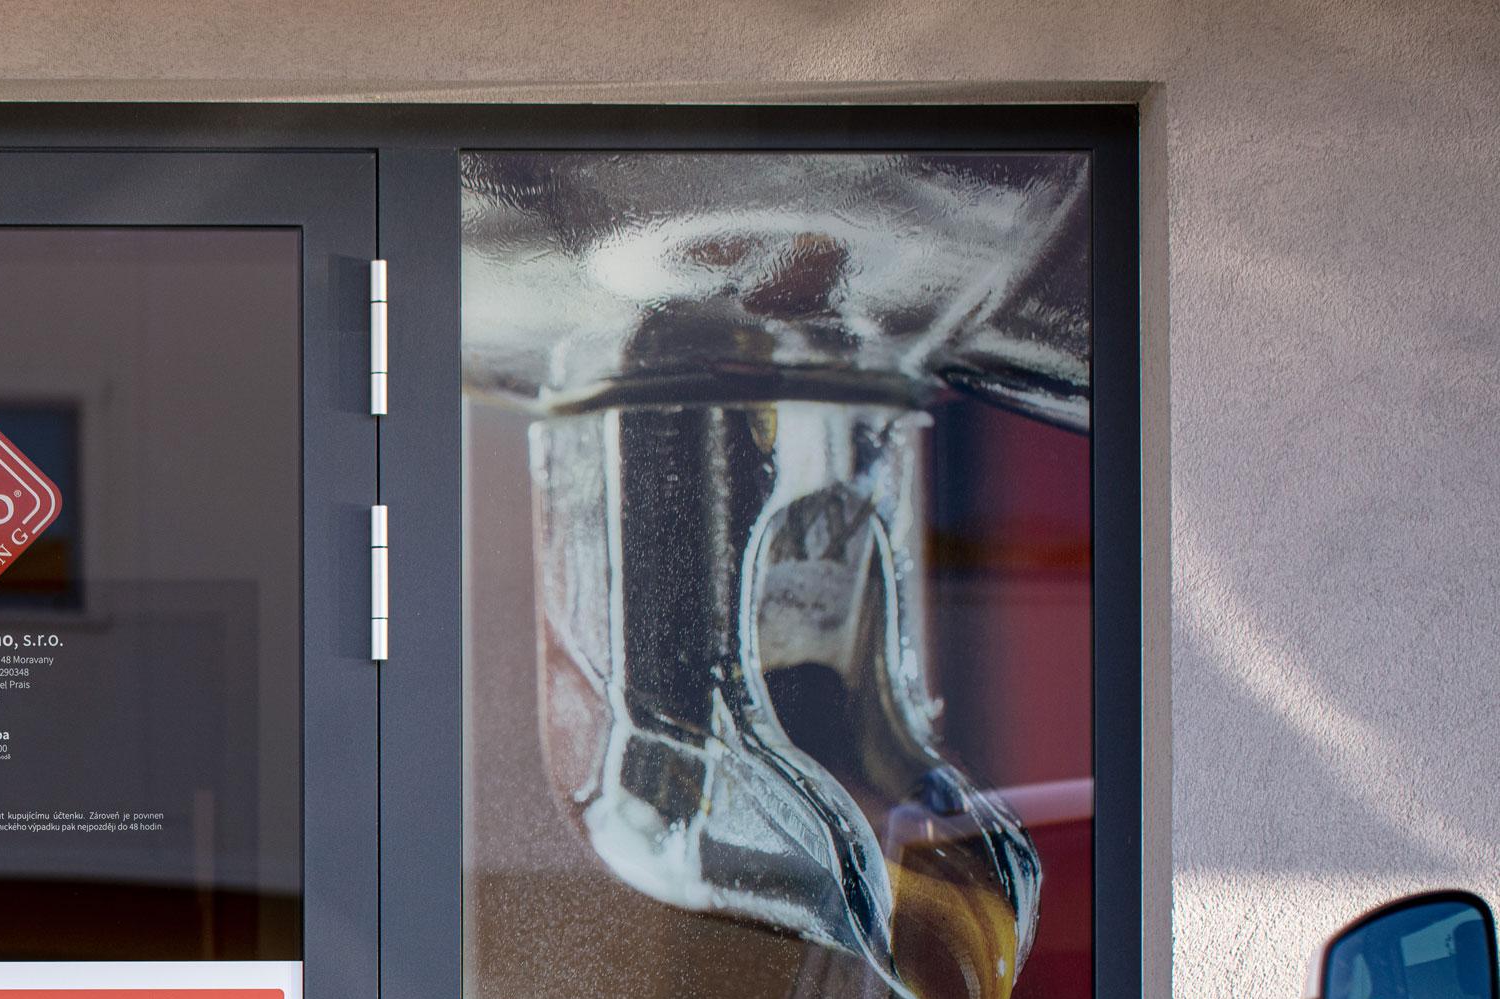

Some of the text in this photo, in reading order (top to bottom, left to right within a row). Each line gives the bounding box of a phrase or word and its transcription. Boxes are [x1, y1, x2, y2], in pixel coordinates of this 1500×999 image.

[22, 634, 64, 648] s.r.o.
[0, 655, 12, 665] 48
[12, 655, 54, 667] Moravany
[9, 680, 31, 690] Prais
[7, 810, 50, 822] kupujícímu
[89, 811, 120, 821] Zároveň
[122, 811, 131, 822] je
[133, 812, 164, 822] povinen
[27, 822, 61, 833] výpadku
[61, 822, 76, 833] pak
[77, 822, 117, 833] nejpozději
[117, 822, 128, 832] do
[128, 822, 139, 832] 48
